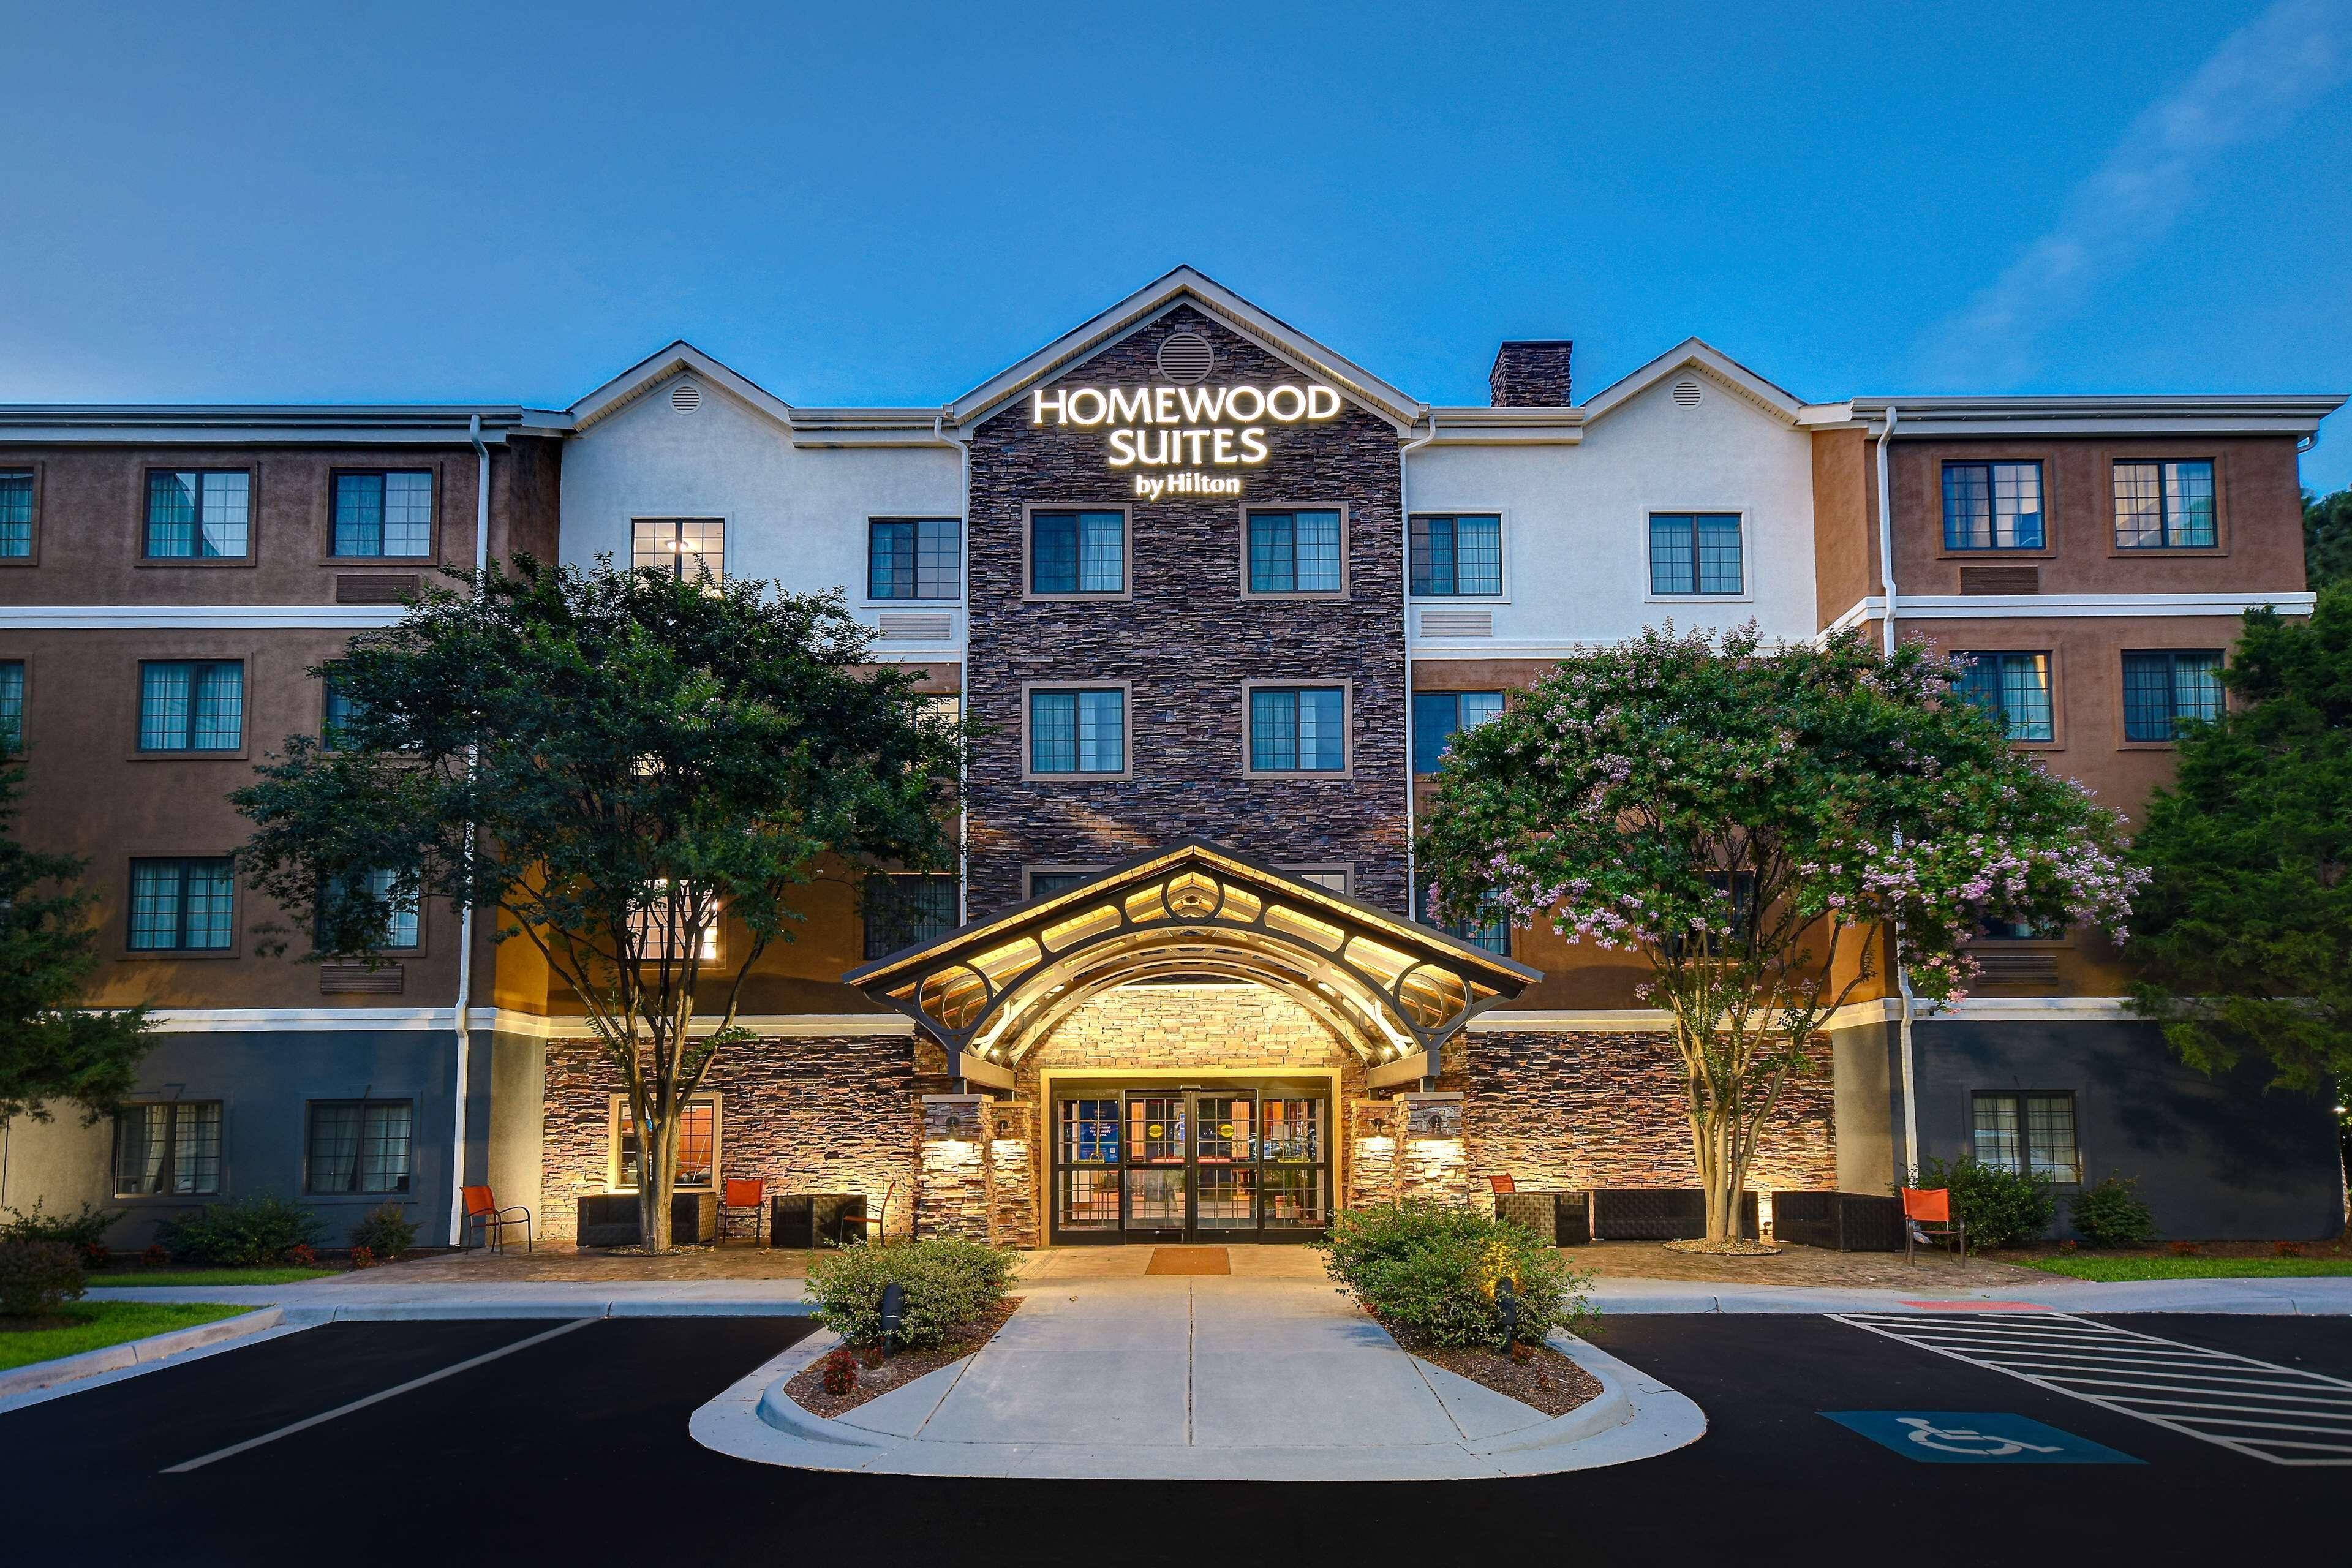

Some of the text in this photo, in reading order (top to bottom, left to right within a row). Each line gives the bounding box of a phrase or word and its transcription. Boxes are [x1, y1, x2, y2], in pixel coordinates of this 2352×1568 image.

[1033, 385, 1340, 425] HOMEWOOD
[1109, 428, 1268, 466] SUITES
[1136, 472, 1240, 500] by Hilton
